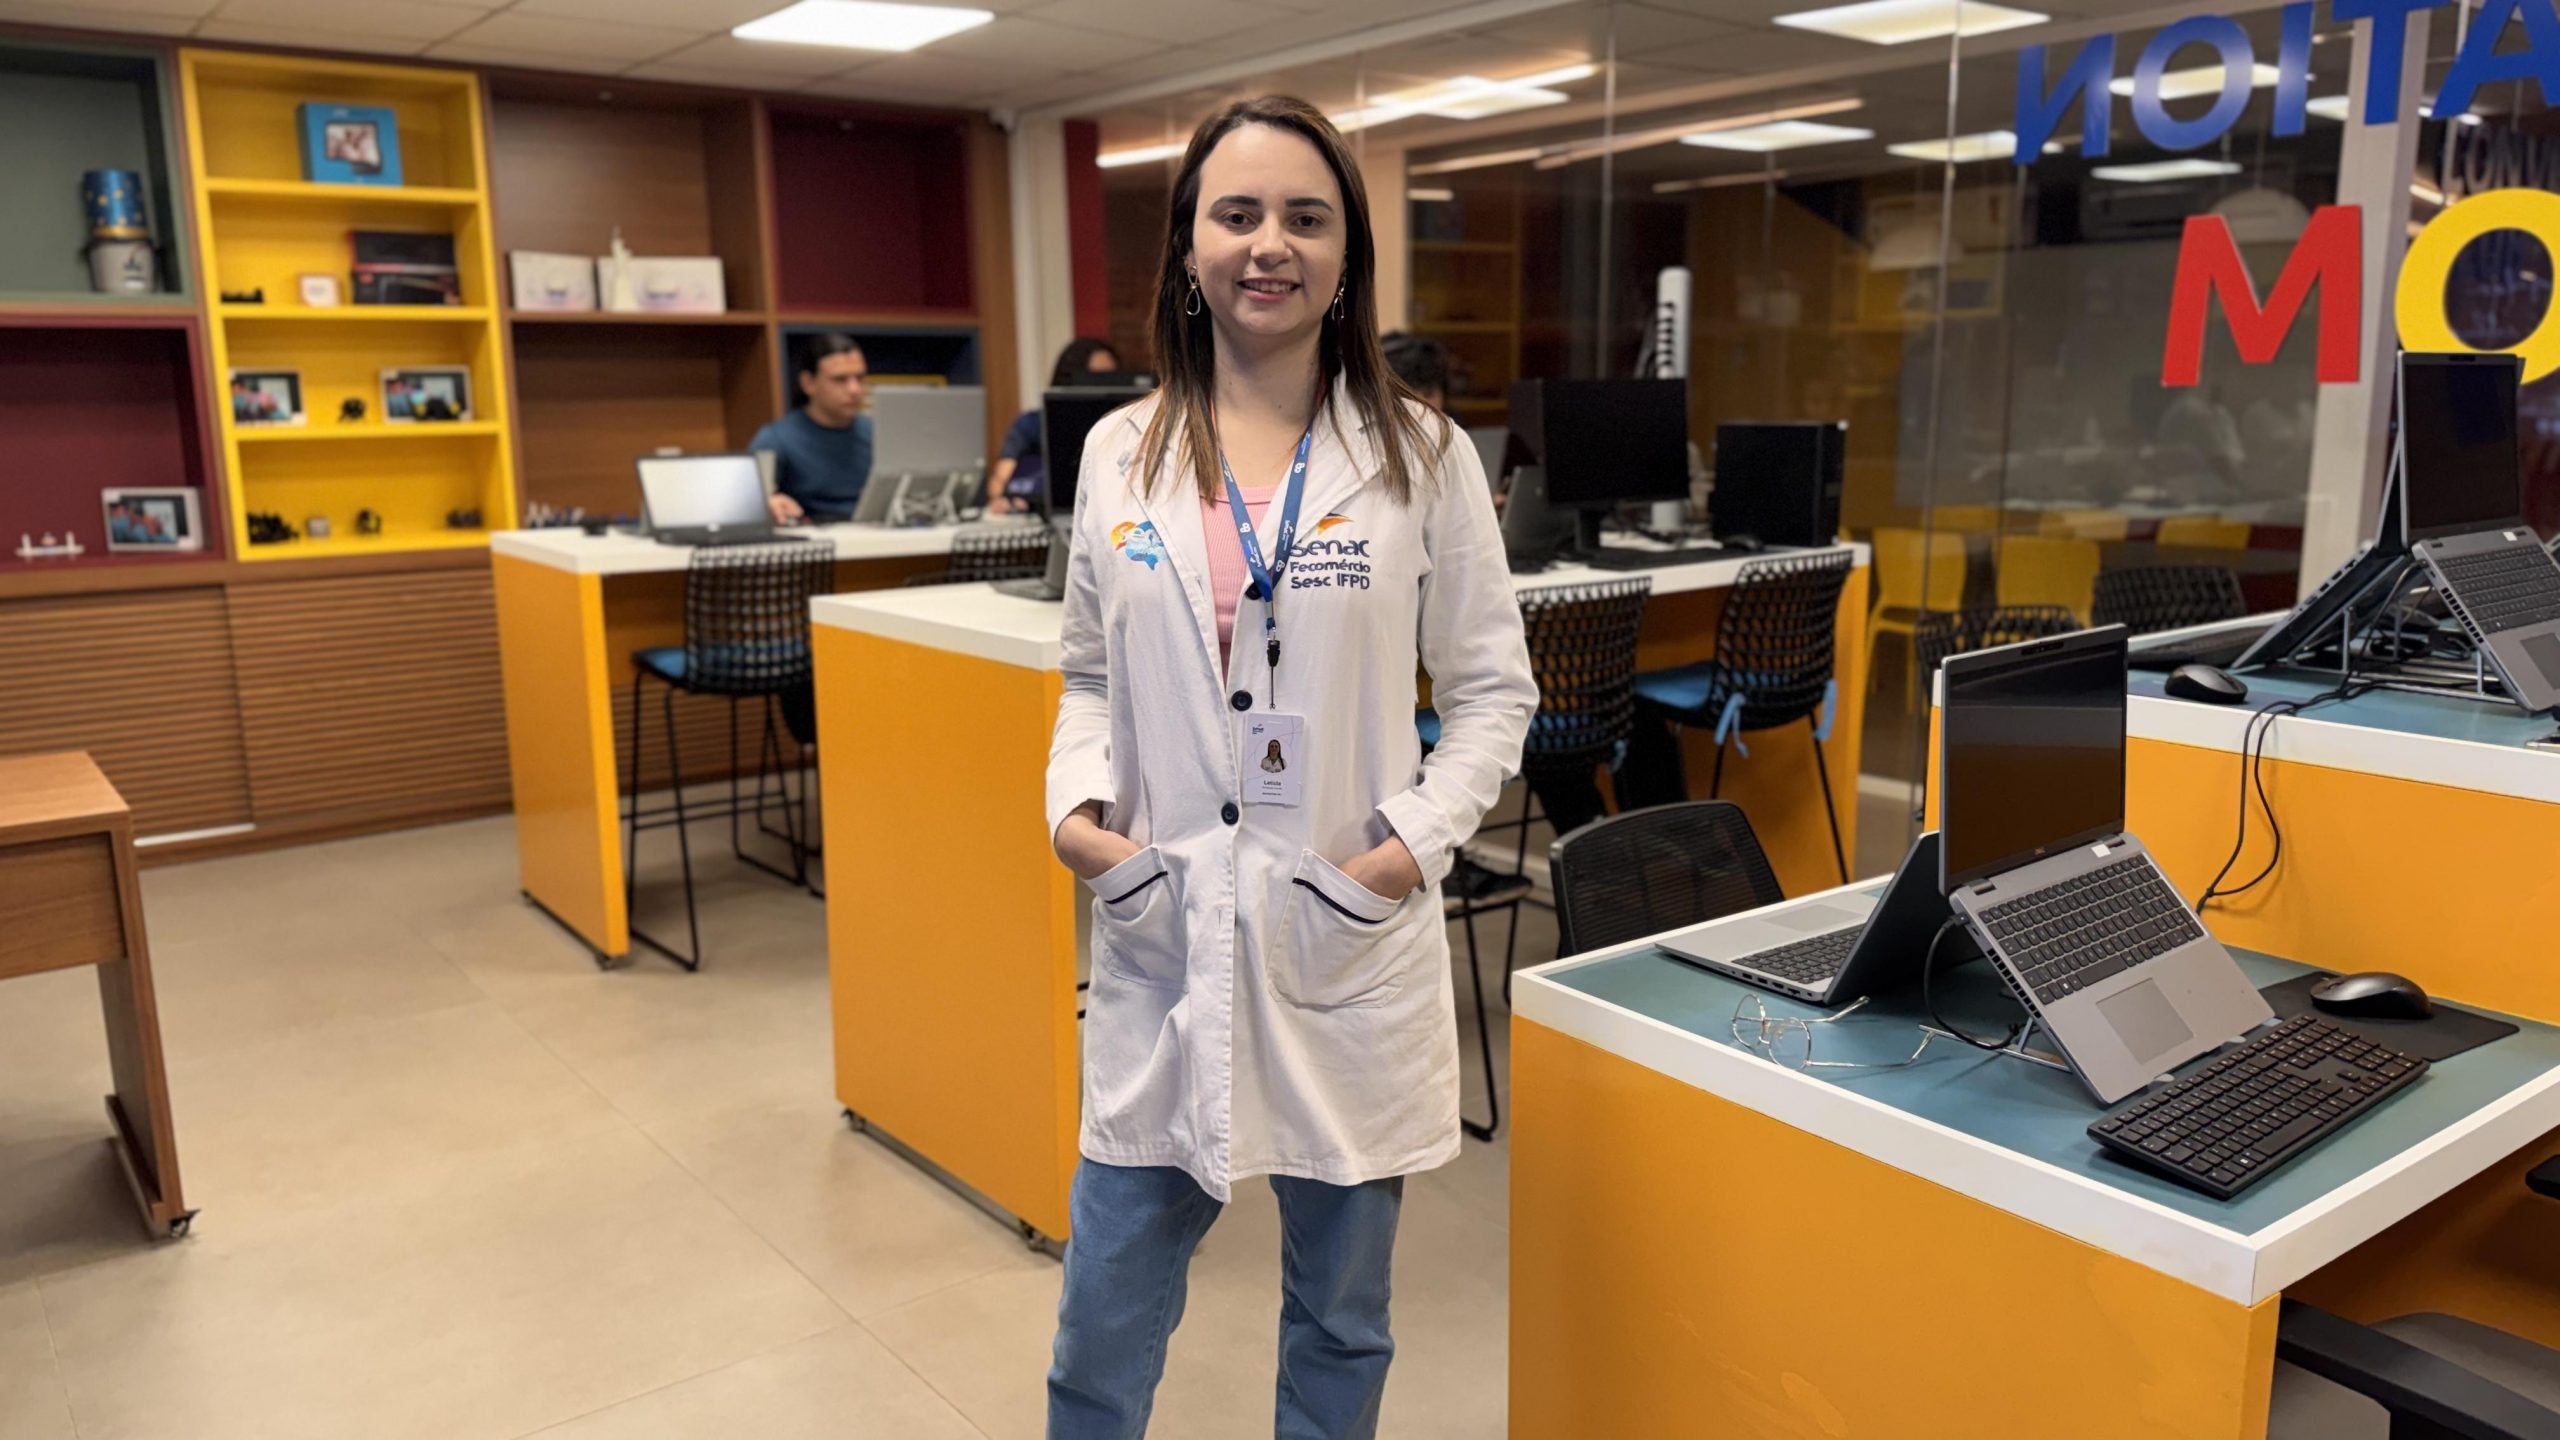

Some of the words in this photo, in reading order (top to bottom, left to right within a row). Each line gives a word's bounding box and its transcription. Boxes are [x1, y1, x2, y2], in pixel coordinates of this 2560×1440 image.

[1290, 558, 1371, 573] Fecomércio
[1291, 576, 1331, 589] Sesc
[1337, 572, 1370, 590] IFPD
